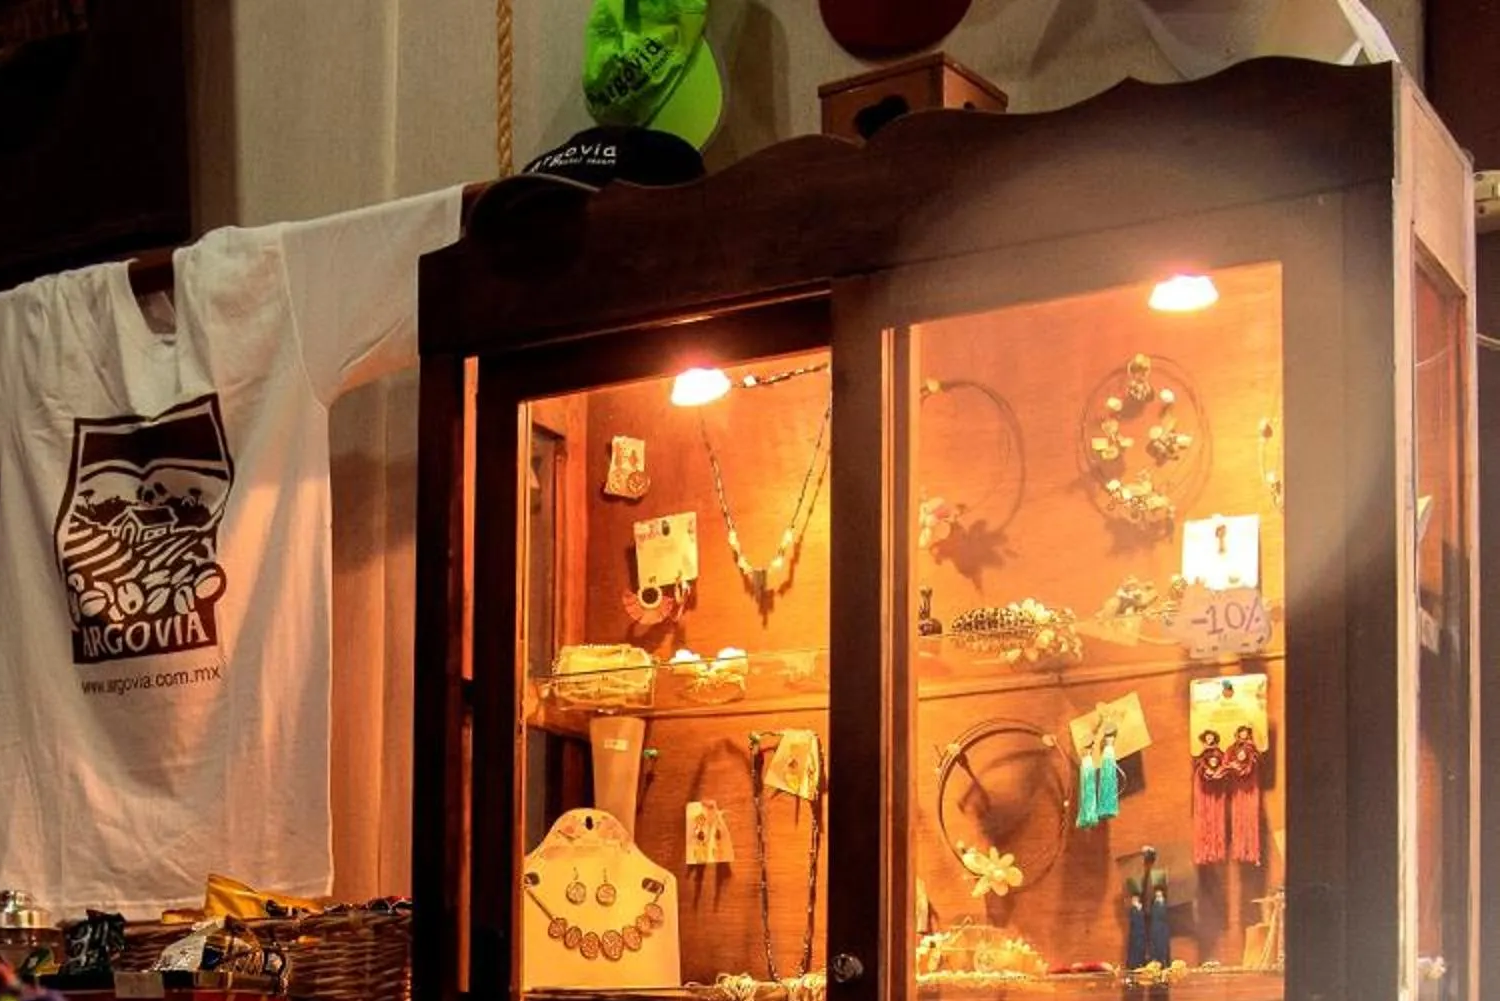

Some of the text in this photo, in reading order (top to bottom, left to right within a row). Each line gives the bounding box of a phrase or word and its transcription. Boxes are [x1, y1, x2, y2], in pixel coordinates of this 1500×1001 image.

[81, 610, 210, 657] ARGOVIA
[1191, 597, 1262, 636] -10%
[81, 664, 222, 695] www.argovia.com.mx
